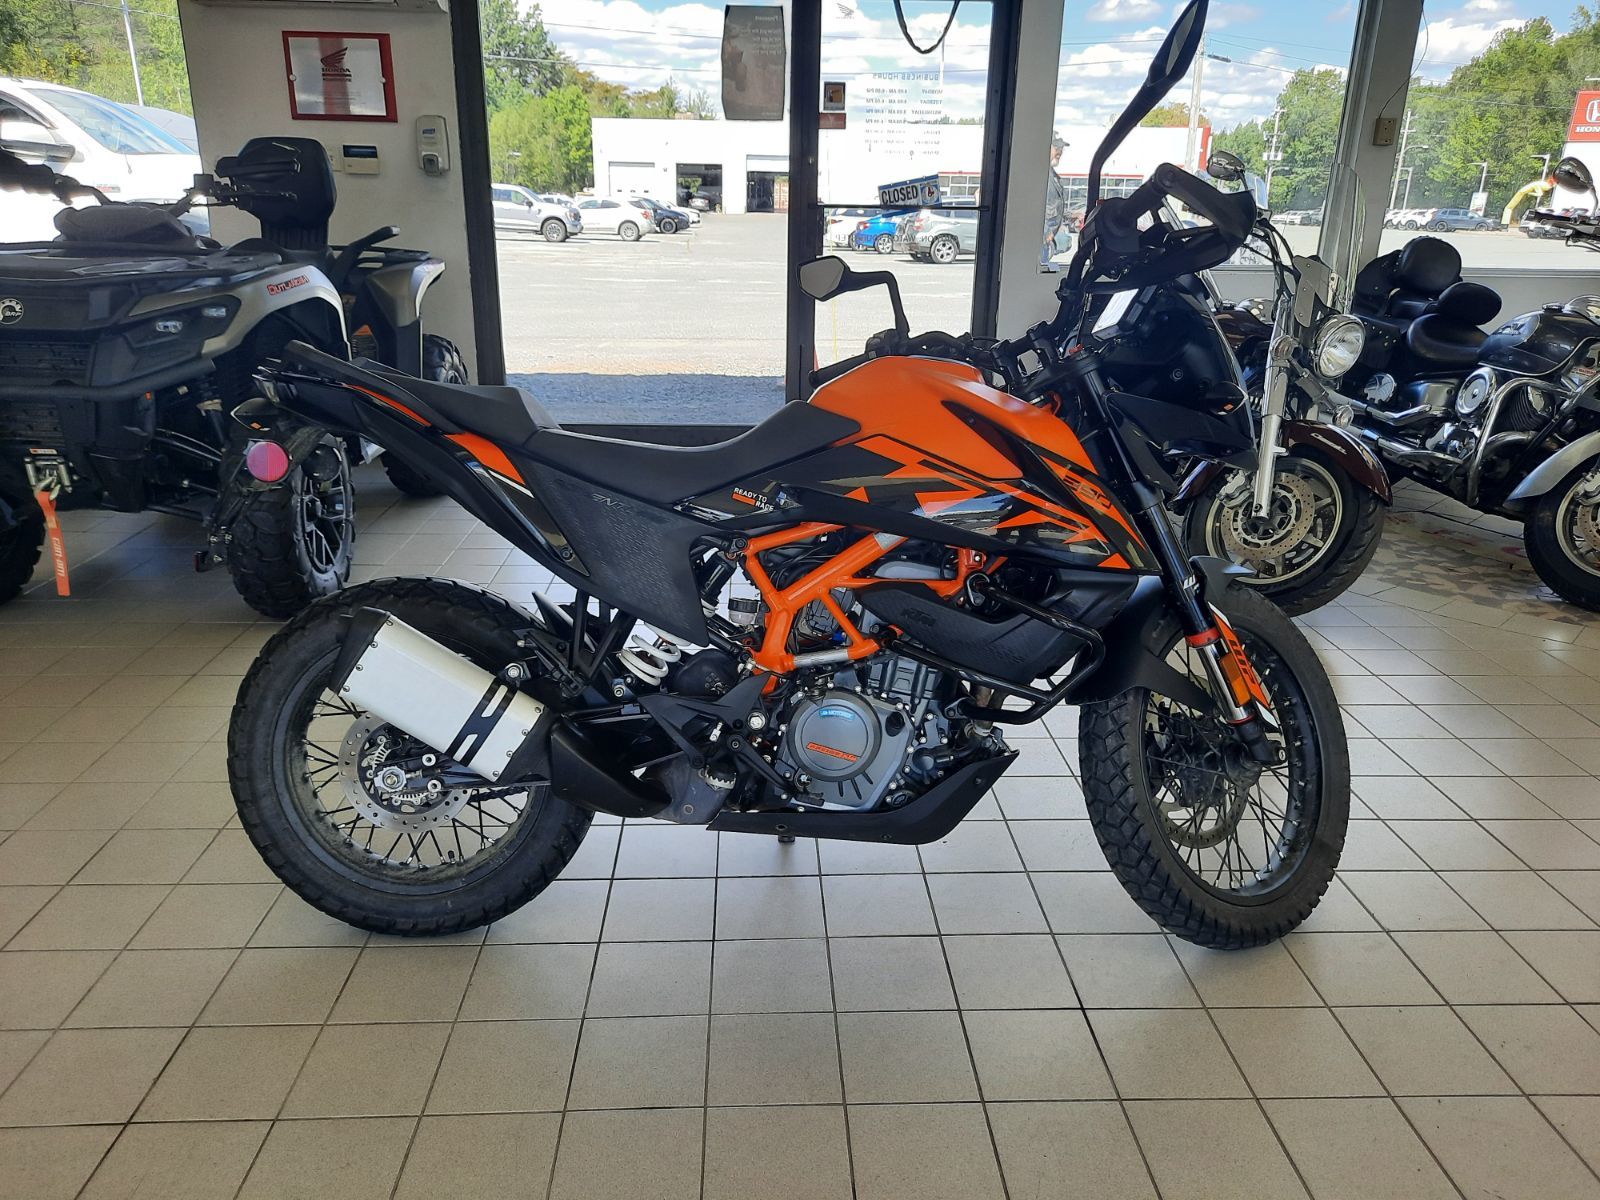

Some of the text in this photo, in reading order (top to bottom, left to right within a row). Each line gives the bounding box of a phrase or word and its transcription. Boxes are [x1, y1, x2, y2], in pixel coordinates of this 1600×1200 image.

[881, 184, 919, 205] CLOSED
[732, 487, 768, 504] READY TO
[755, 500, 775, 512] RACE
